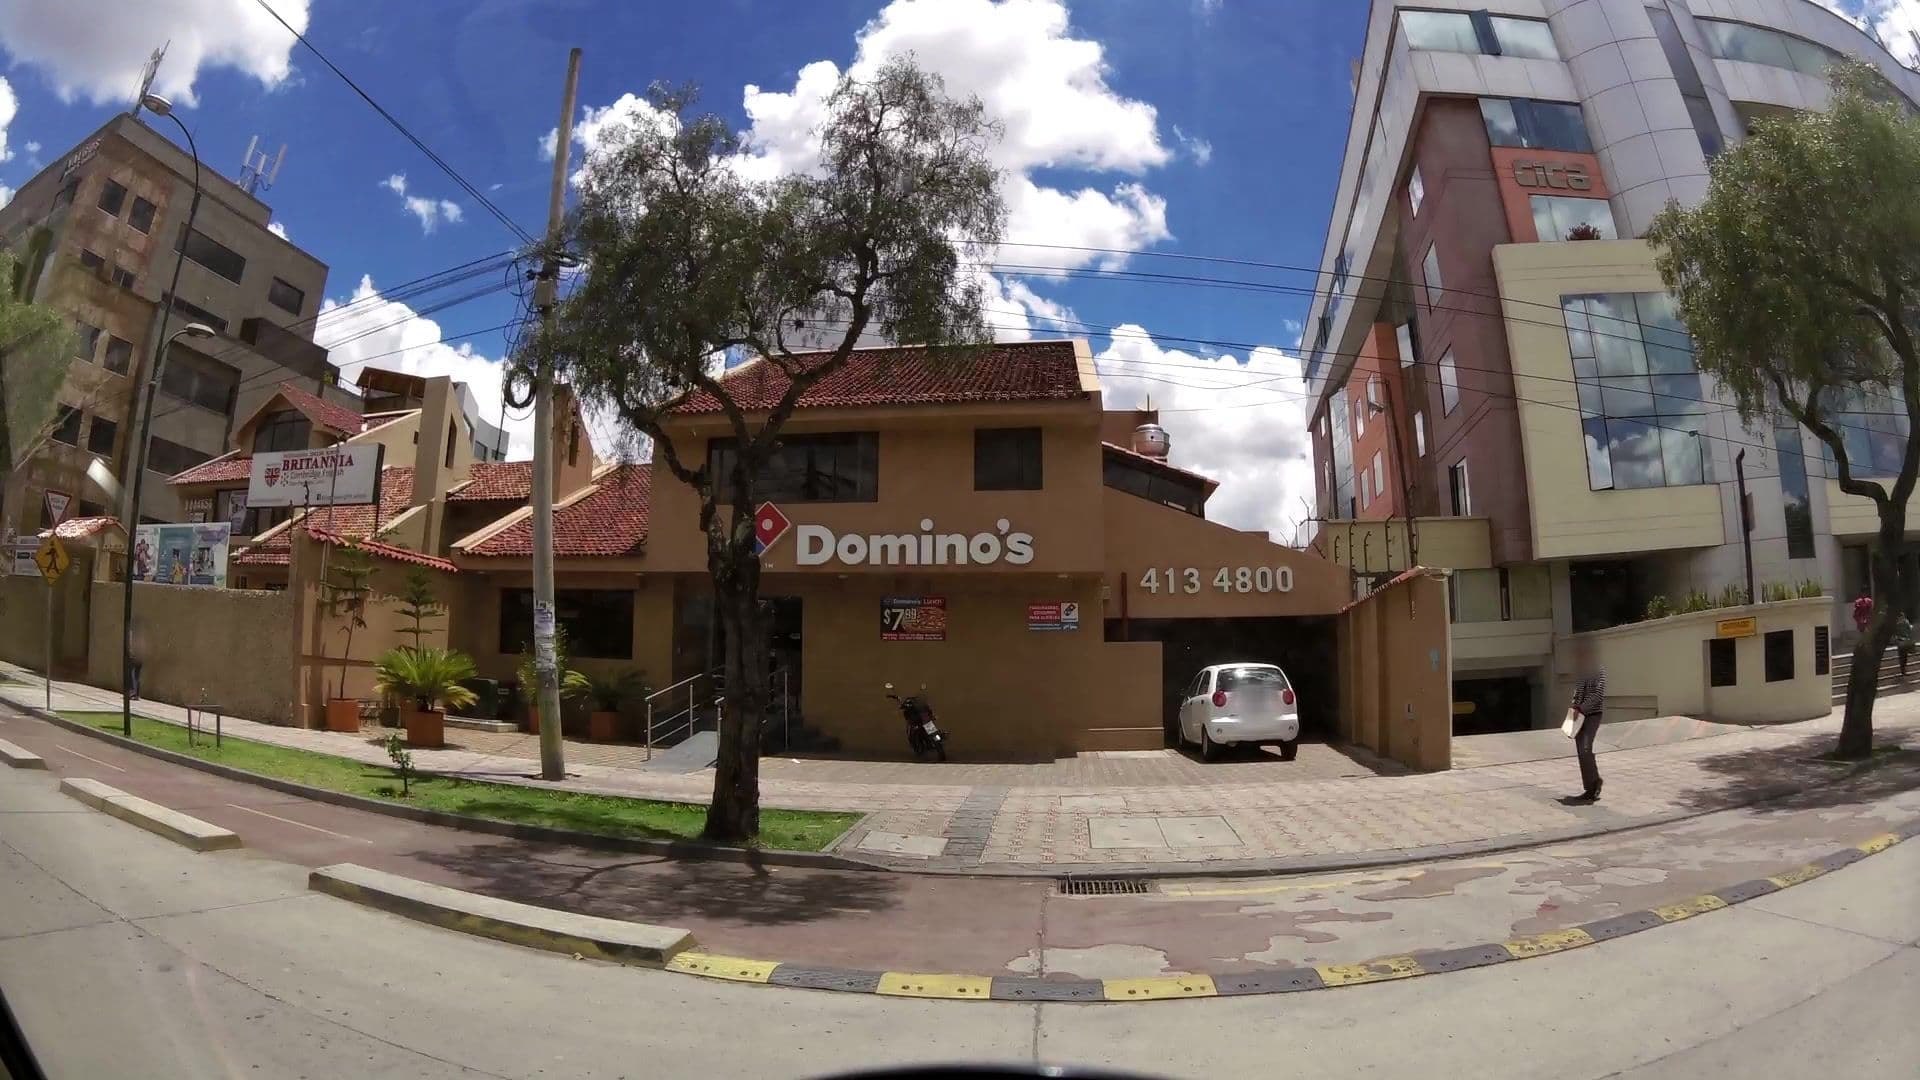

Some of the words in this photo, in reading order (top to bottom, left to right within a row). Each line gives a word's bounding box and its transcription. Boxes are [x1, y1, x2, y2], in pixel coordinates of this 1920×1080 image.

[282, 454, 354, 471] BRITANNIA
[797, 518, 1034, 565] Domino's
[1140, 567, 1200, 594] 413
[1213, 566, 1293, 593] 4800
